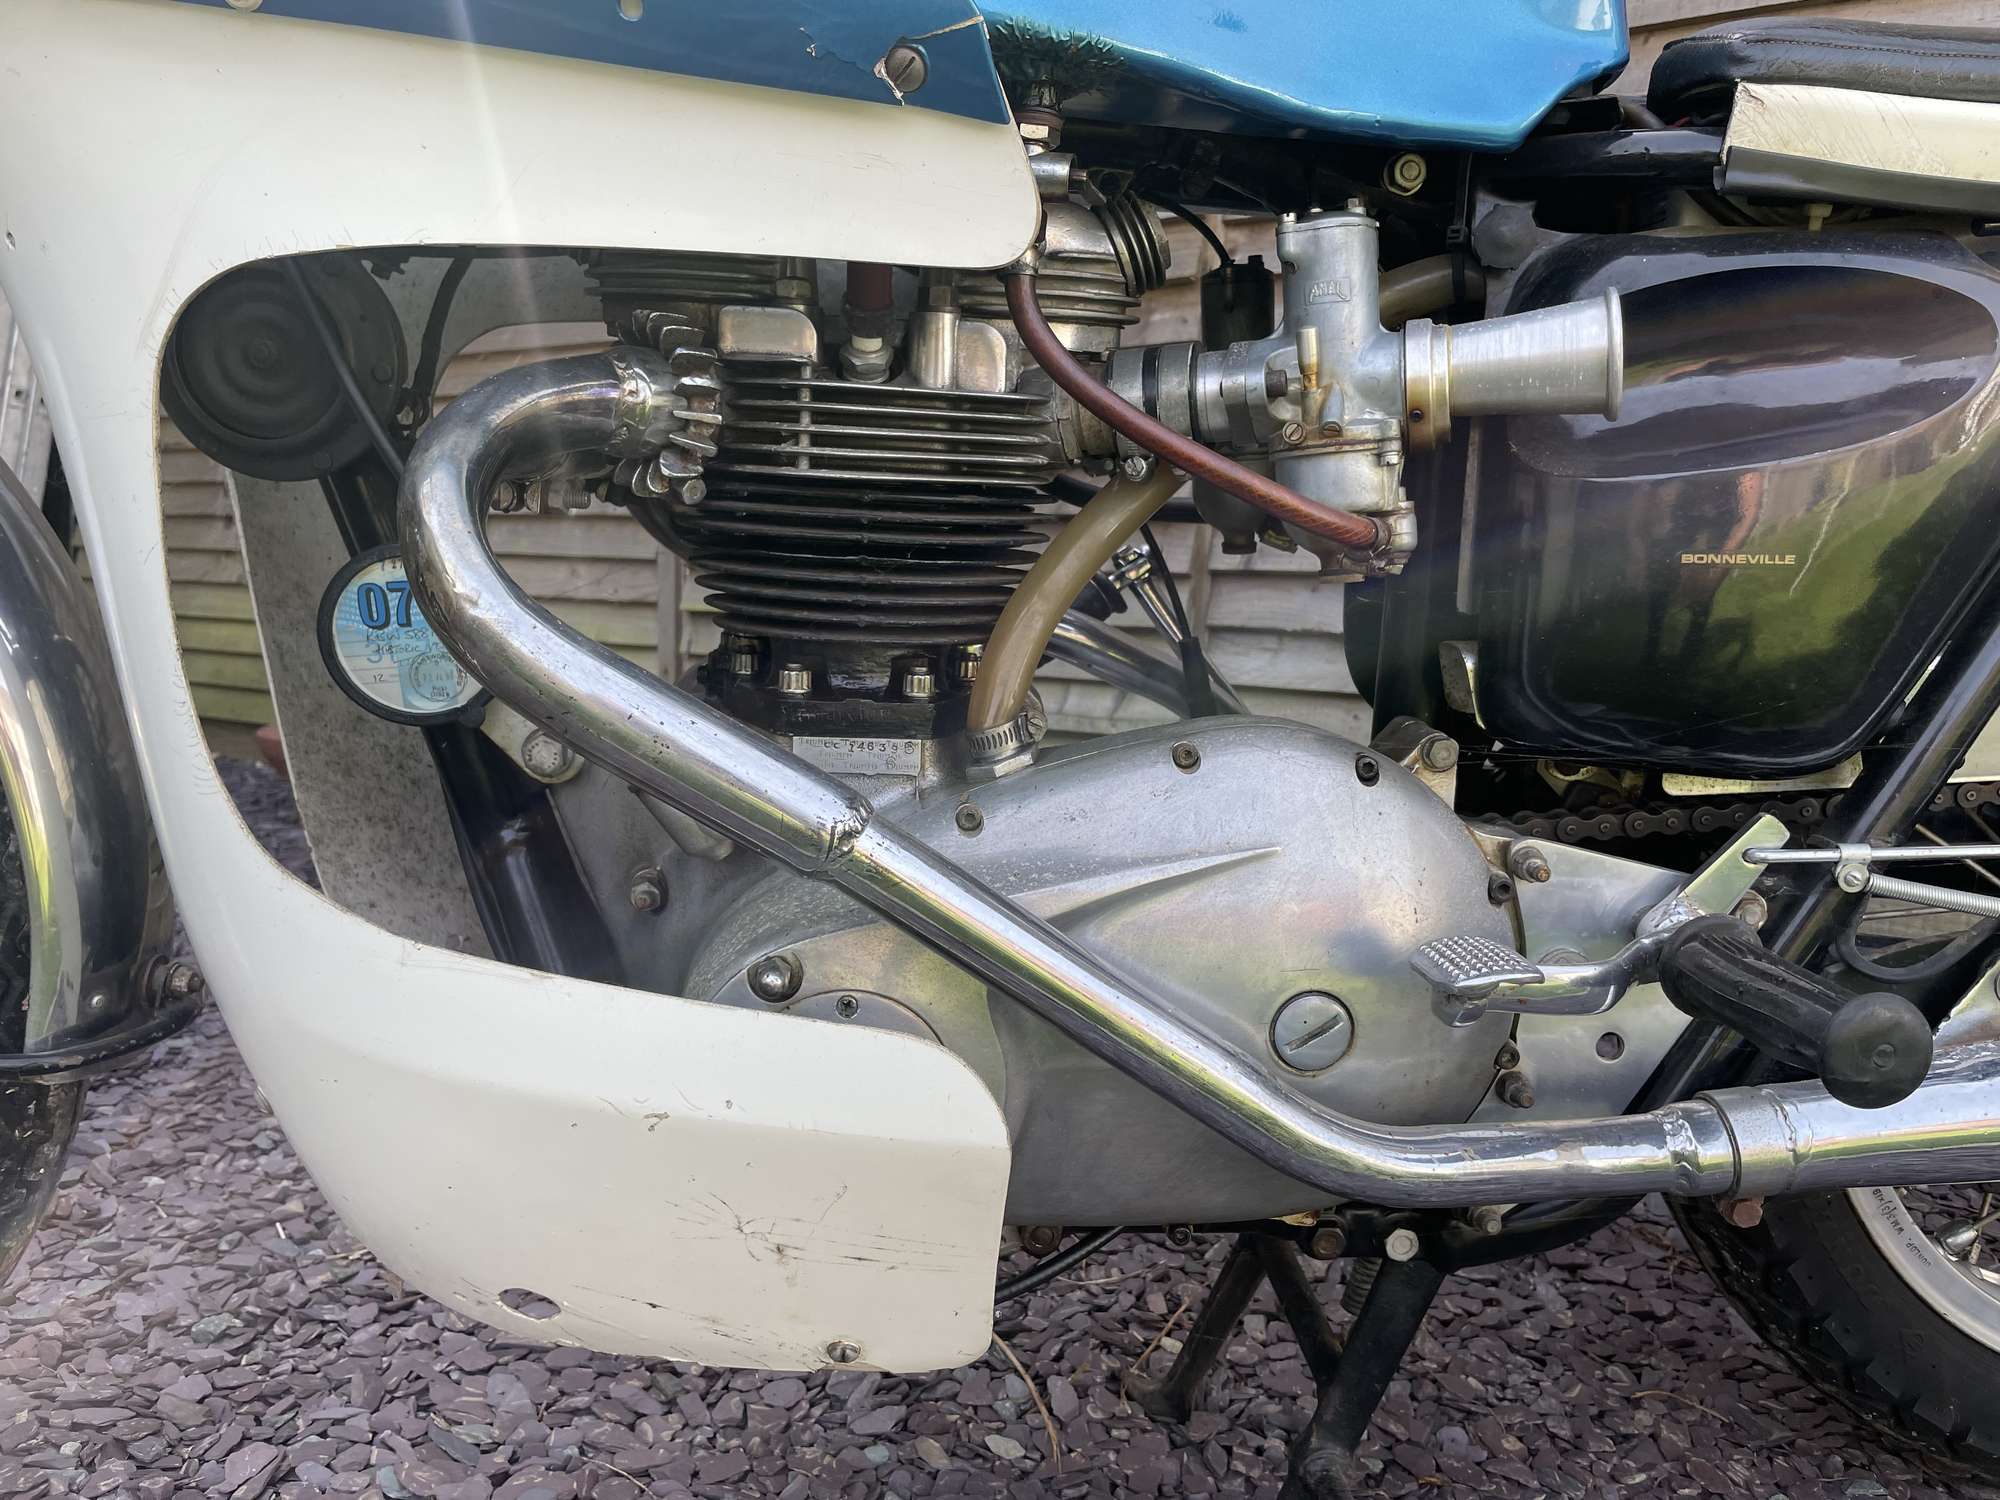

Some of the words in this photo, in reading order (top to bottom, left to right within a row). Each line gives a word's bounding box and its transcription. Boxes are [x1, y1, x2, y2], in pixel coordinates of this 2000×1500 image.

[1309, 281, 1350, 302] AMAL
[1681, 553, 1797, 565] BONNEVILLE
[357, 580, 413, 631] 07
